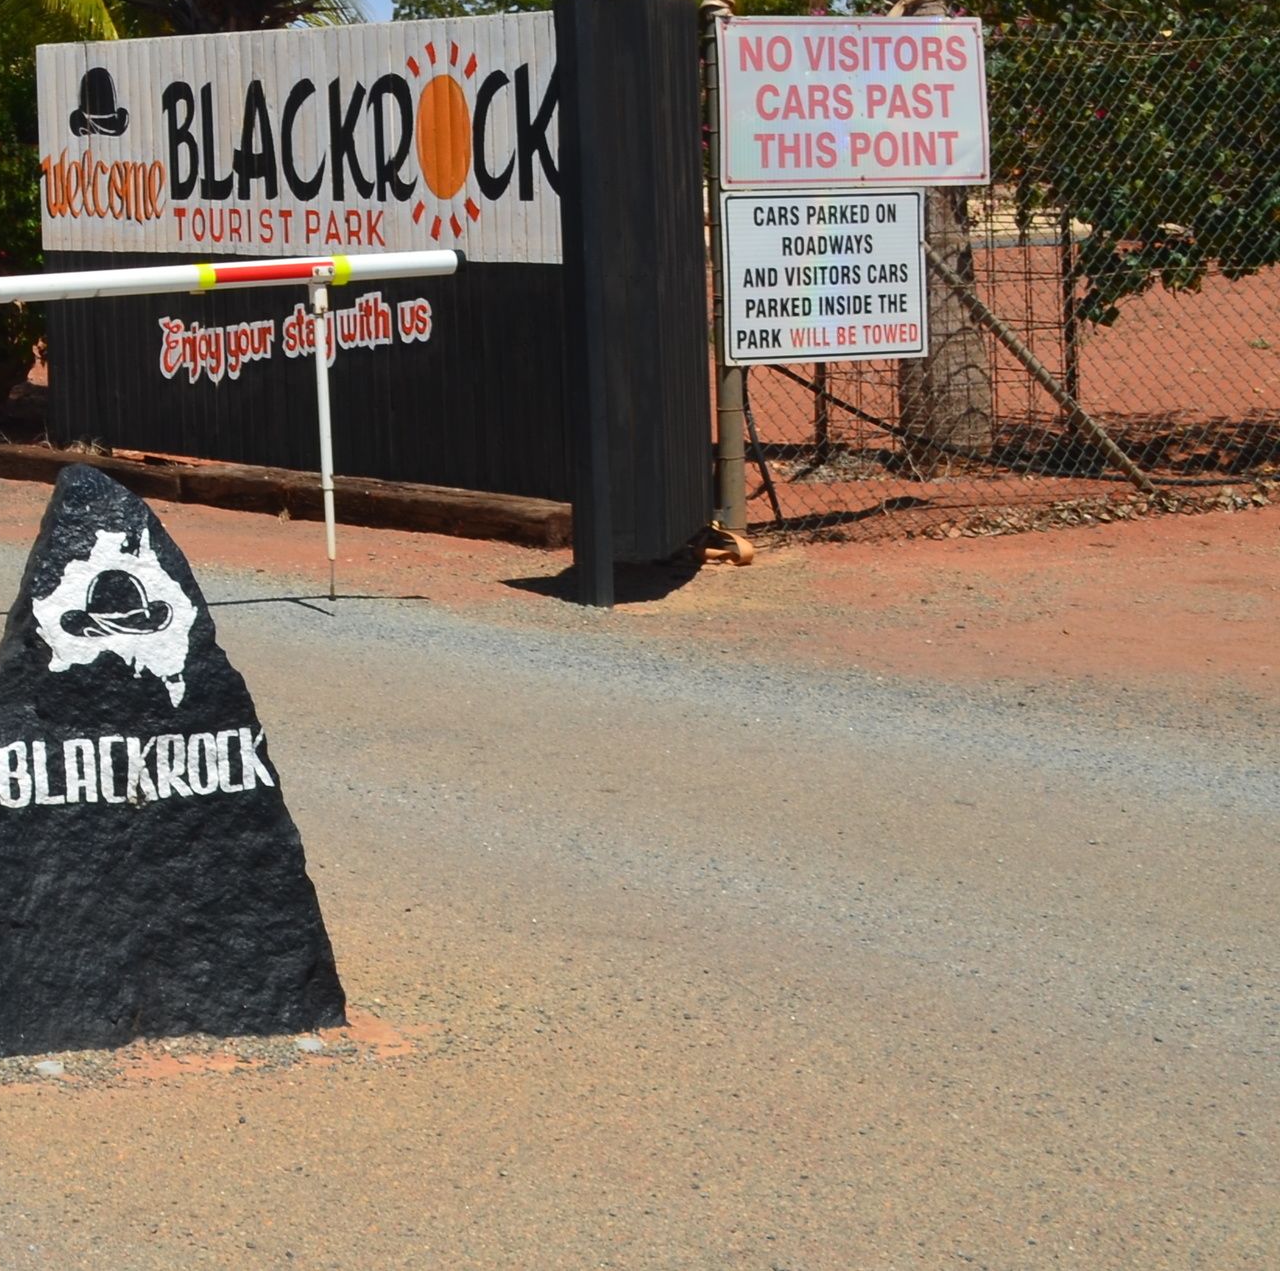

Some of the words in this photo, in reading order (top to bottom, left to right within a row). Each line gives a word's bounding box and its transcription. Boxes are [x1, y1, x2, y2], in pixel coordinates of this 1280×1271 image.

[738, 35, 792, 72] NO
[803, 35, 968, 72] VISITORS
[755, 83, 855, 120] CARS
[865, 83, 955, 119] PAST
[162, 63, 562, 202] BLACKROCK
[753, 131, 838, 168] THIS
[849, 131, 959, 167] POINT
[173, 207, 293, 244] TOURIST
[305, 209, 386, 247] PARK
[753, 206, 800, 227] CARS
[806, 204, 870, 226] PARKED
[875, 203, 897, 224] ON
[781, 234, 873, 257] ROADWAYS
[743, 267, 778, 288] AND
[784, 264, 861, 287] VISITORS
[867, 263, 909, 284] CARS
[745, 297, 813, 319] PARKED
[818, 295, 873, 316] INSIDE
[877, 293, 908, 313] THE
[159, 317, 227, 385] Enjoy
[226, 321, 275, 380] your
[336, 291, 393, 350] with
[397, 298, 432, 343] us
[736, 328, 783, 350] PARK
[790, 327, 831, 349] WILL
[836, 326, 857, 345] BE
[862, 323, 918, 345] TOWED
